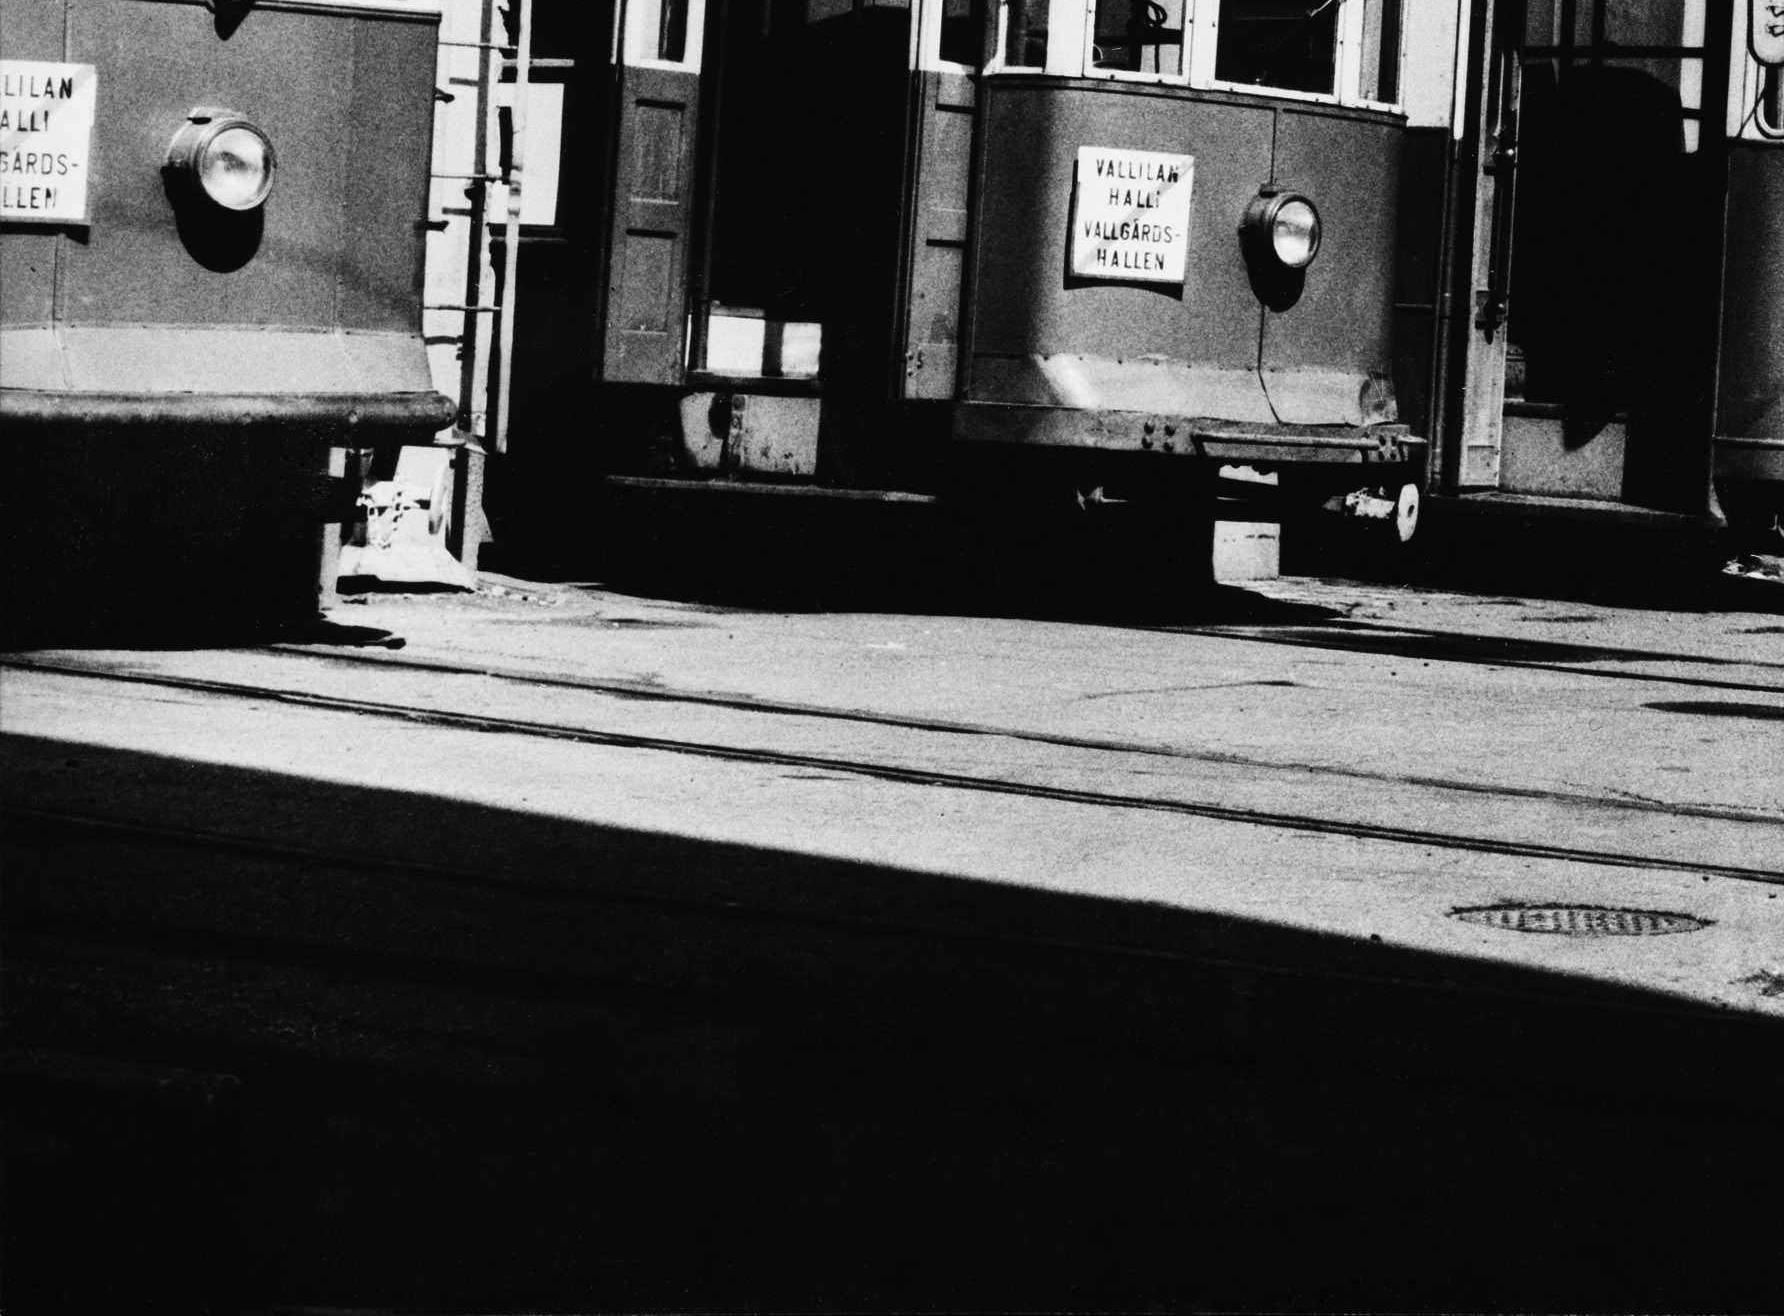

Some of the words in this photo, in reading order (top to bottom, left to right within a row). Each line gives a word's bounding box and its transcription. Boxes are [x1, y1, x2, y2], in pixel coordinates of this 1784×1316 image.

[0, 75, 73, 99] LILAN
[1096, 159, 1179, 183] VALLILAN
[1109, 188, 1160, 208] HALLI
[1097, 248, 1165, 271] HALLEN
